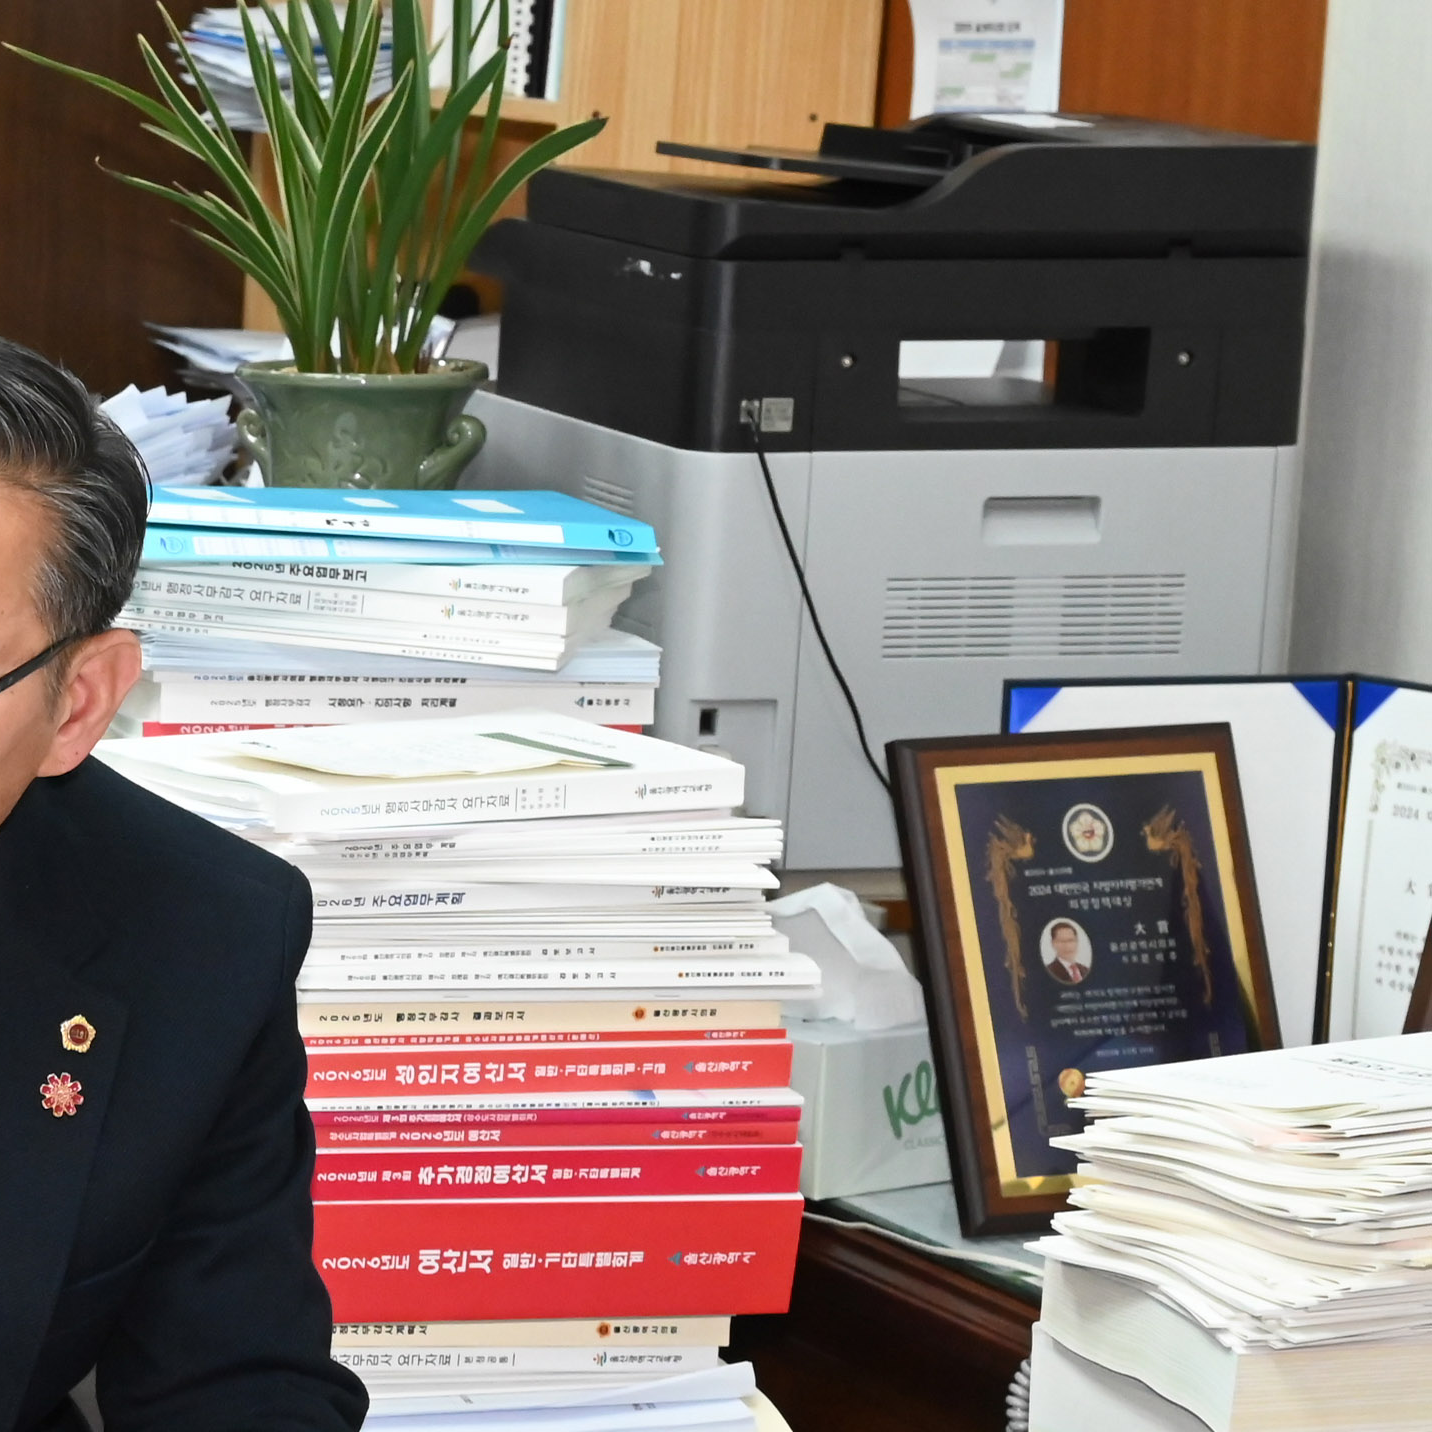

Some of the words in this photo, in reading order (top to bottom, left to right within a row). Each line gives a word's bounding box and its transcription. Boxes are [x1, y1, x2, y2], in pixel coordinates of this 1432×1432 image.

[232, 560, 286, 580] 2025년
[288, 563, 368, 583] 주요업무보고
[166, 579, 245, 602] 행정사무감사
[248, 587, 303, 607] 요구자료
[319, 802, 381, 817] 2025년도
[384, 796, 459, 815] 행정사무감사
[462, 793, 510, 811] 요구자료
[371, 891, 467, 910] 주요업무계획
[318, 1012, 383, 1023] 2025년도
[396, 1011, 460, 1023] 행정사무감사
[312, 1067, 387, 1082] 2026년도
[394, 1061, 527, 1086] 성인지예산서
[694, 1060, 753, 1074] 울산광역시
[399, 1130, 465, 1142] 2026년도
[468, 1129, 501, 1142] 예산서
[317, 1170, 377, 1182] 2025년도
[382, 1170, 412, 1182] 제3회
[418, 1164, 548, 1186] 추가경정예산서
[706, 1165, 762, 1178] 울산광역시
[322, 1254, 411, 1271] 2026년도
[417, 1248, 495, 1275] 예산서
[502, 1250, 645, 1270] 일반·기타특별회계
[683, 1251, 757, 1266] 울산광역시
[397, 1353, 451, 1367] 요구자료
